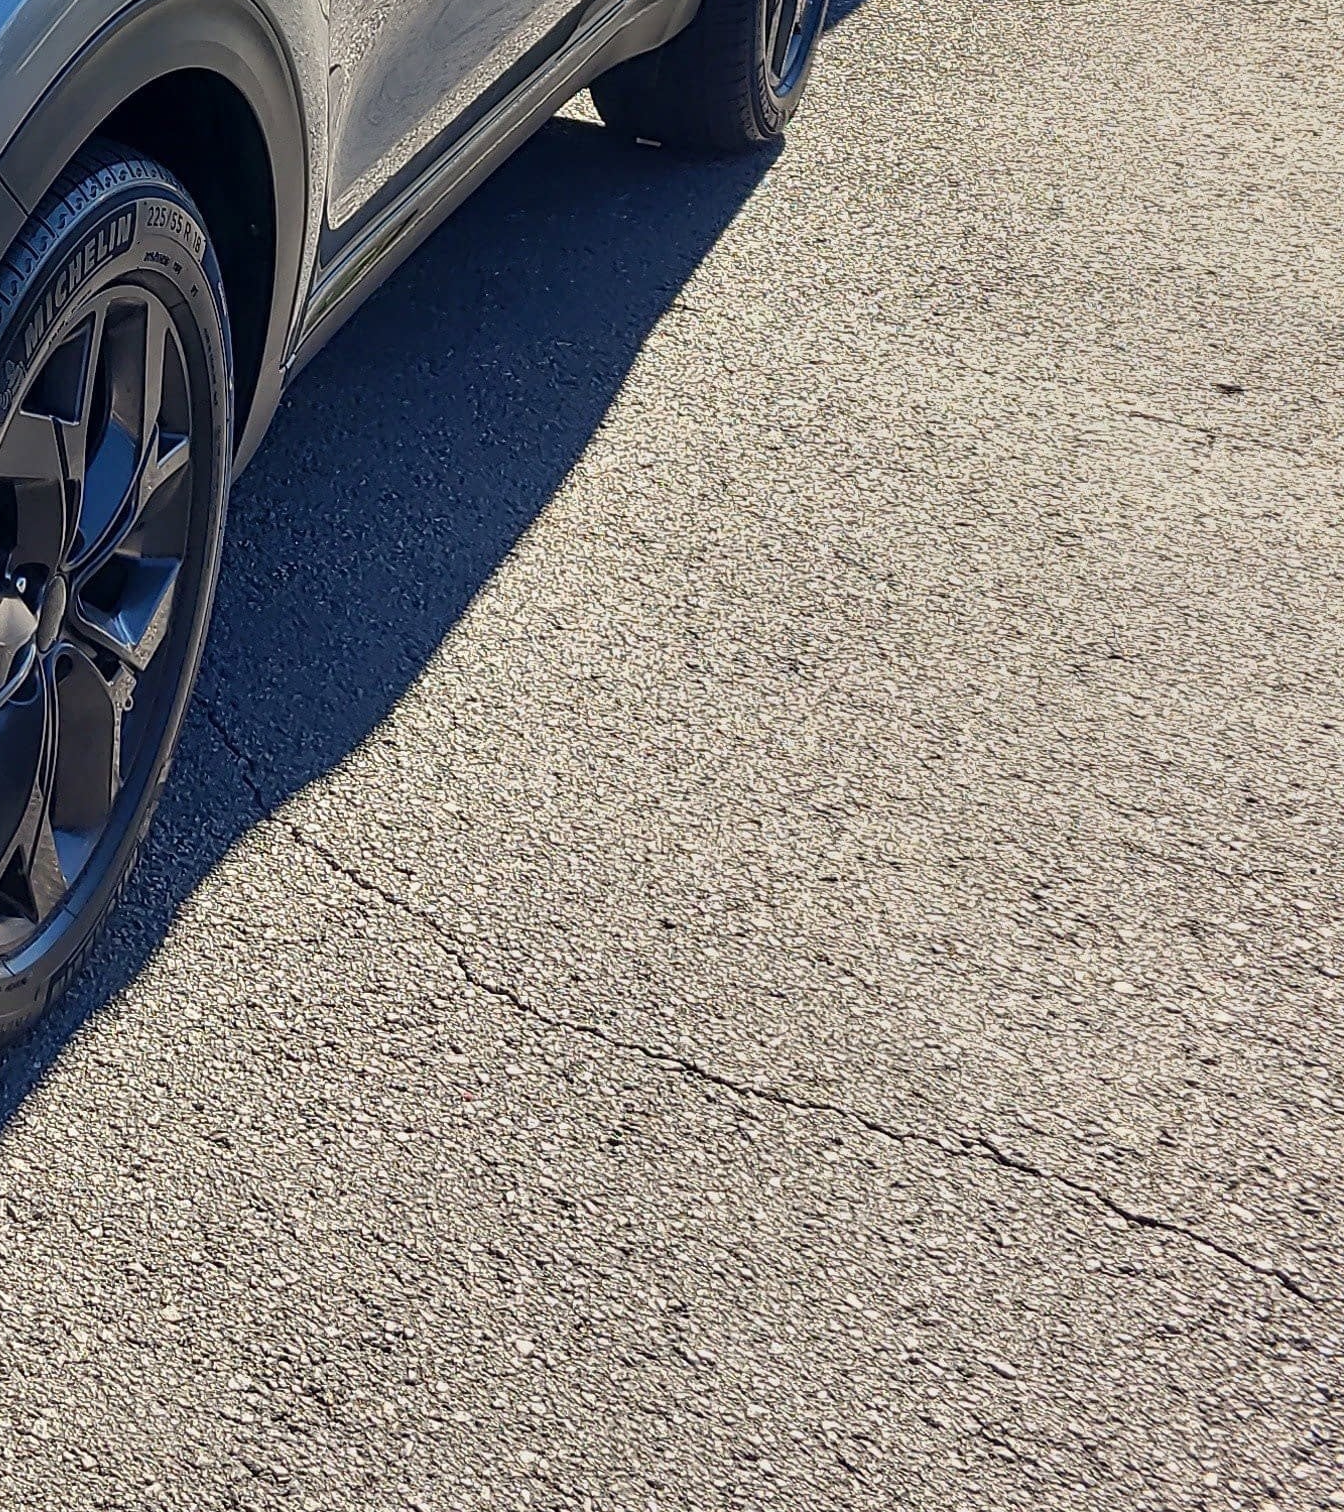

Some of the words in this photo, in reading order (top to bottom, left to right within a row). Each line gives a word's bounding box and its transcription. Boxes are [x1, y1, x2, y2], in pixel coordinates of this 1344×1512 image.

[146, 206, 183, 234] 225/55
[193, 231, 202, 254] 18
[24, 211, 133, 358] MICHELIN
